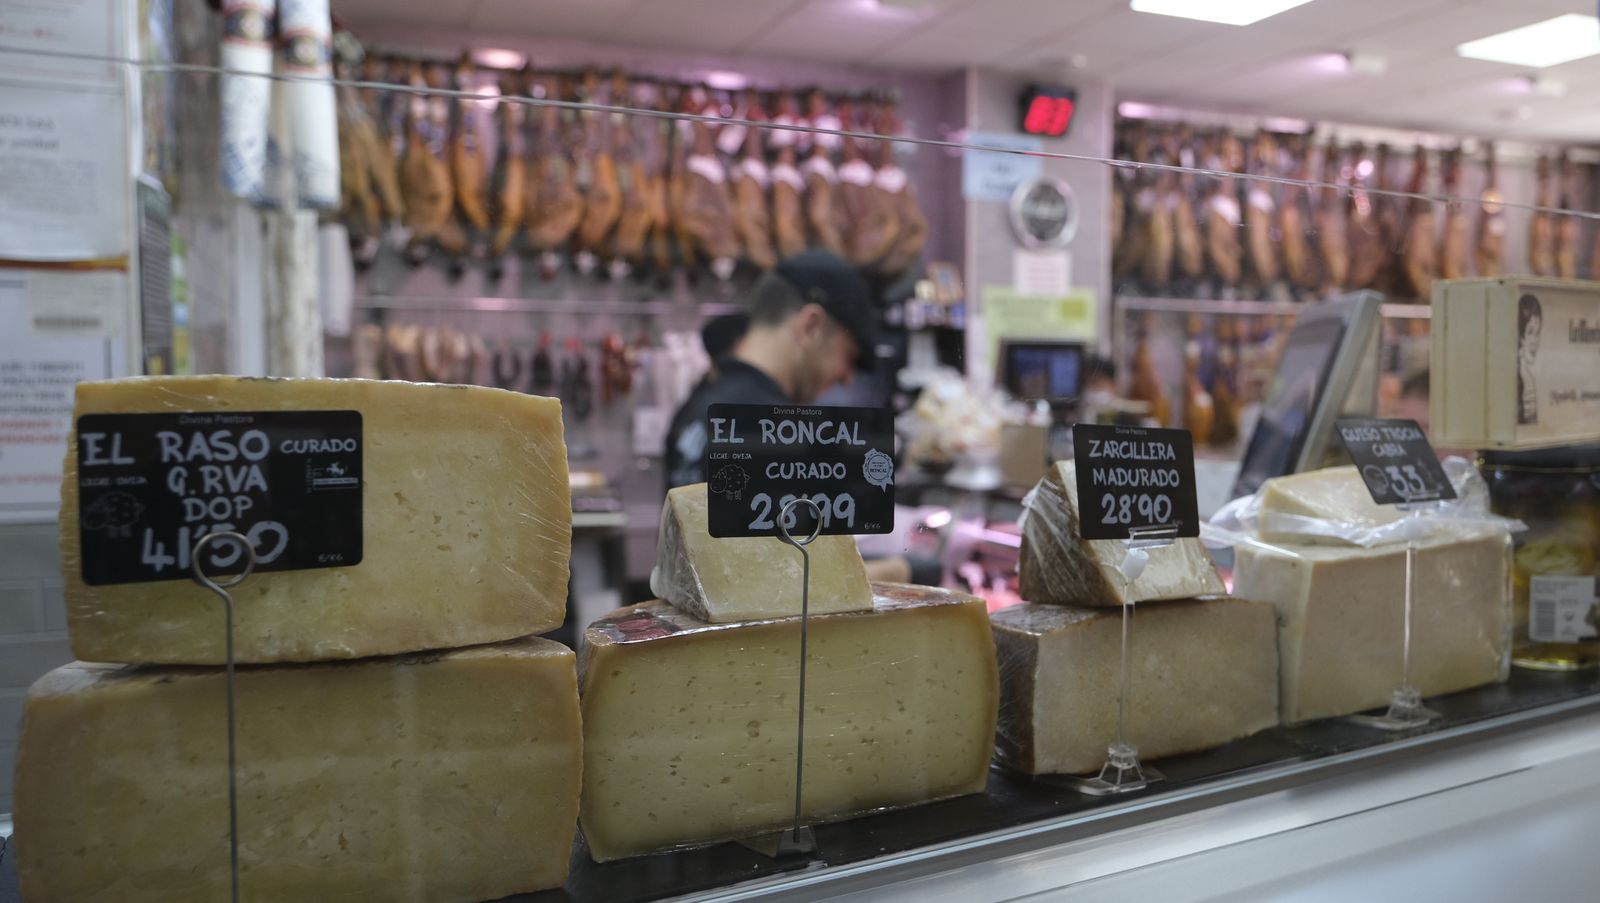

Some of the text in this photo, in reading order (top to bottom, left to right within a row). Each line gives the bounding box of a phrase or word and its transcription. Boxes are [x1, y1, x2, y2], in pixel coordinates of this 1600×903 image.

[773, 407, 822, 416] Divina Pastora
[710, 419, 866, 445] EL RONCAL
[81, 429, 357, 466] EL RASO CURADO
[1088, 440, 1176, 461] ZARCILLERA
[765, 462, 847, 480] CURADO
[1092, 467, 1180, 488] MADURADO
[183, 496, 253, 522] DOP
[748, 492, 856, 530] 28'99
[1101, 492, 1172, 525] 28'90
